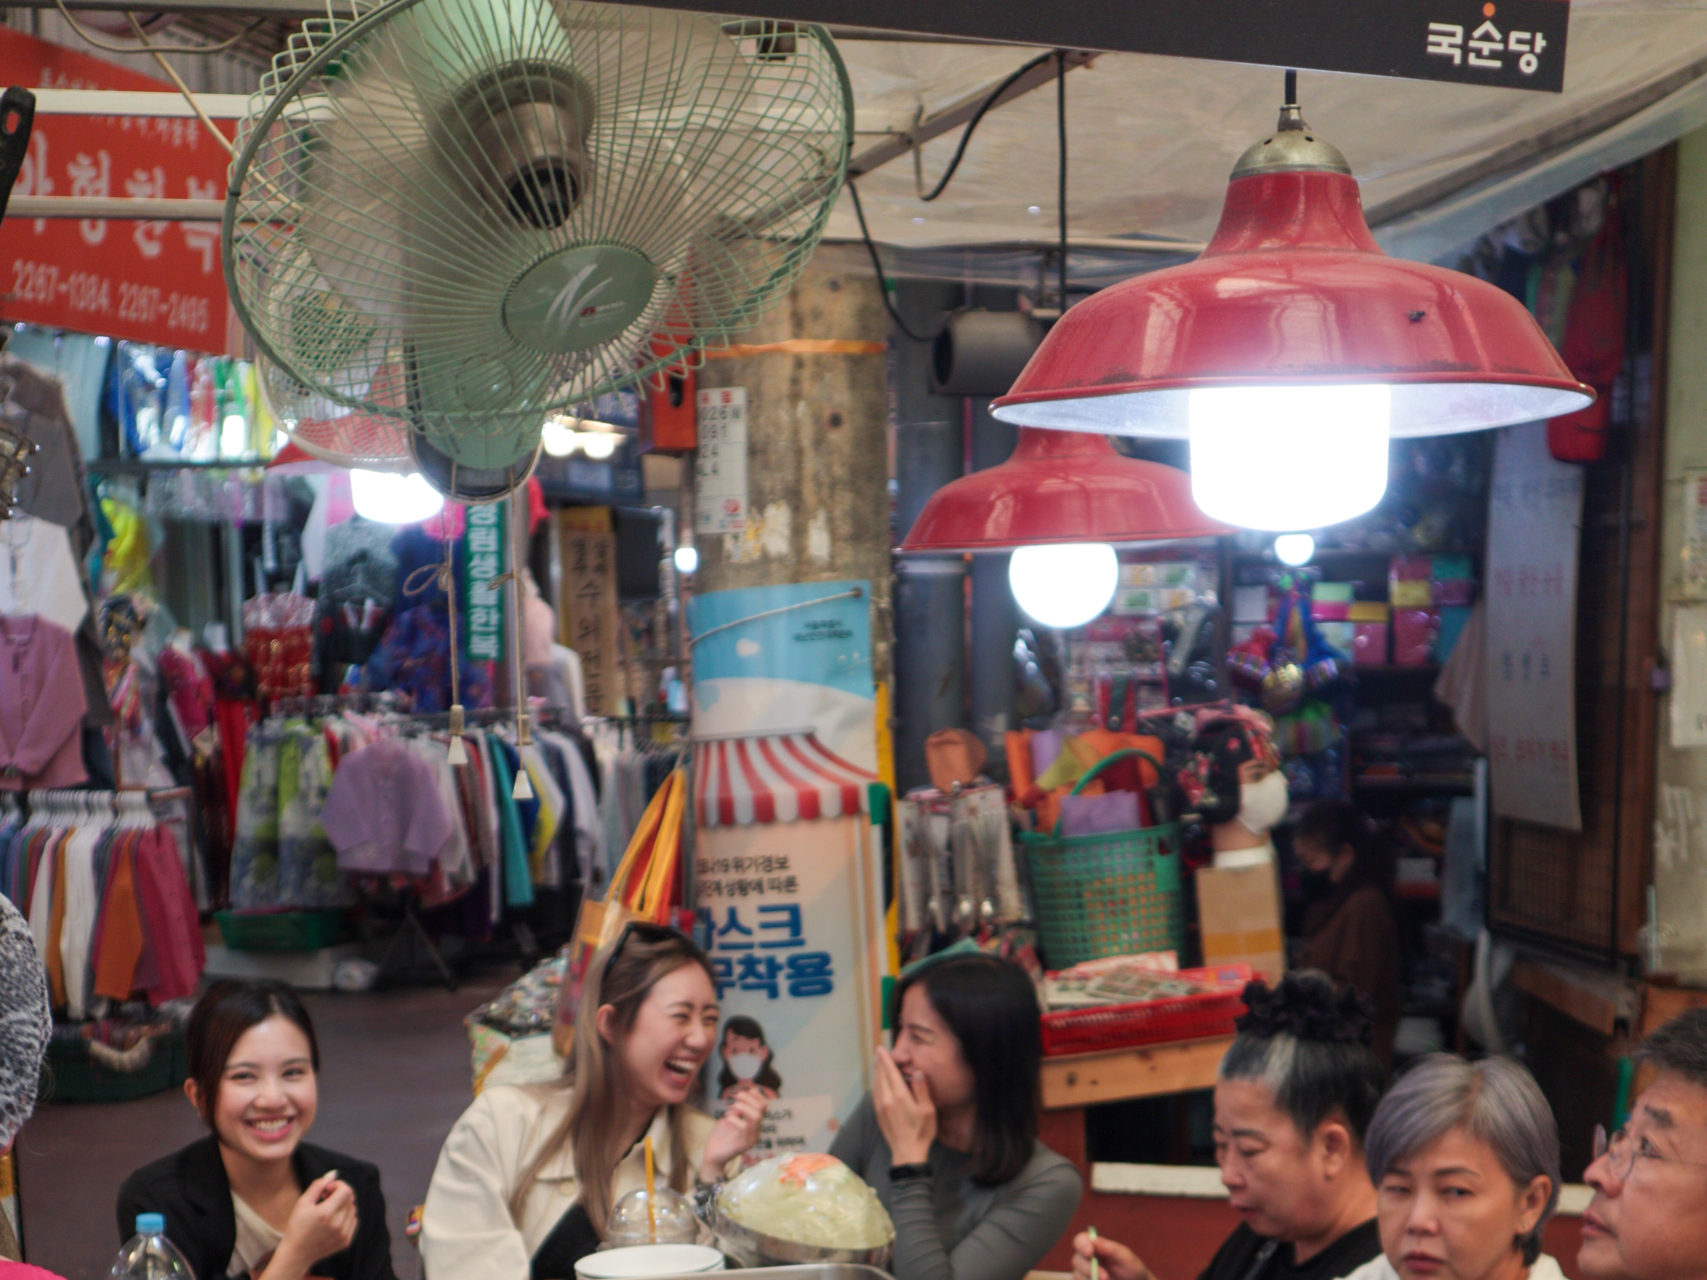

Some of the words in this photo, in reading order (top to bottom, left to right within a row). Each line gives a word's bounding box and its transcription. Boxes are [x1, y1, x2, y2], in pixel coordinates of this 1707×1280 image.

[1427, 19, 1547, 75] 국순당
[731, 853, 791, 874] 위기경보
[725, 877, 765, 897] 상황에
[767, 874, 799, 894] 따른
